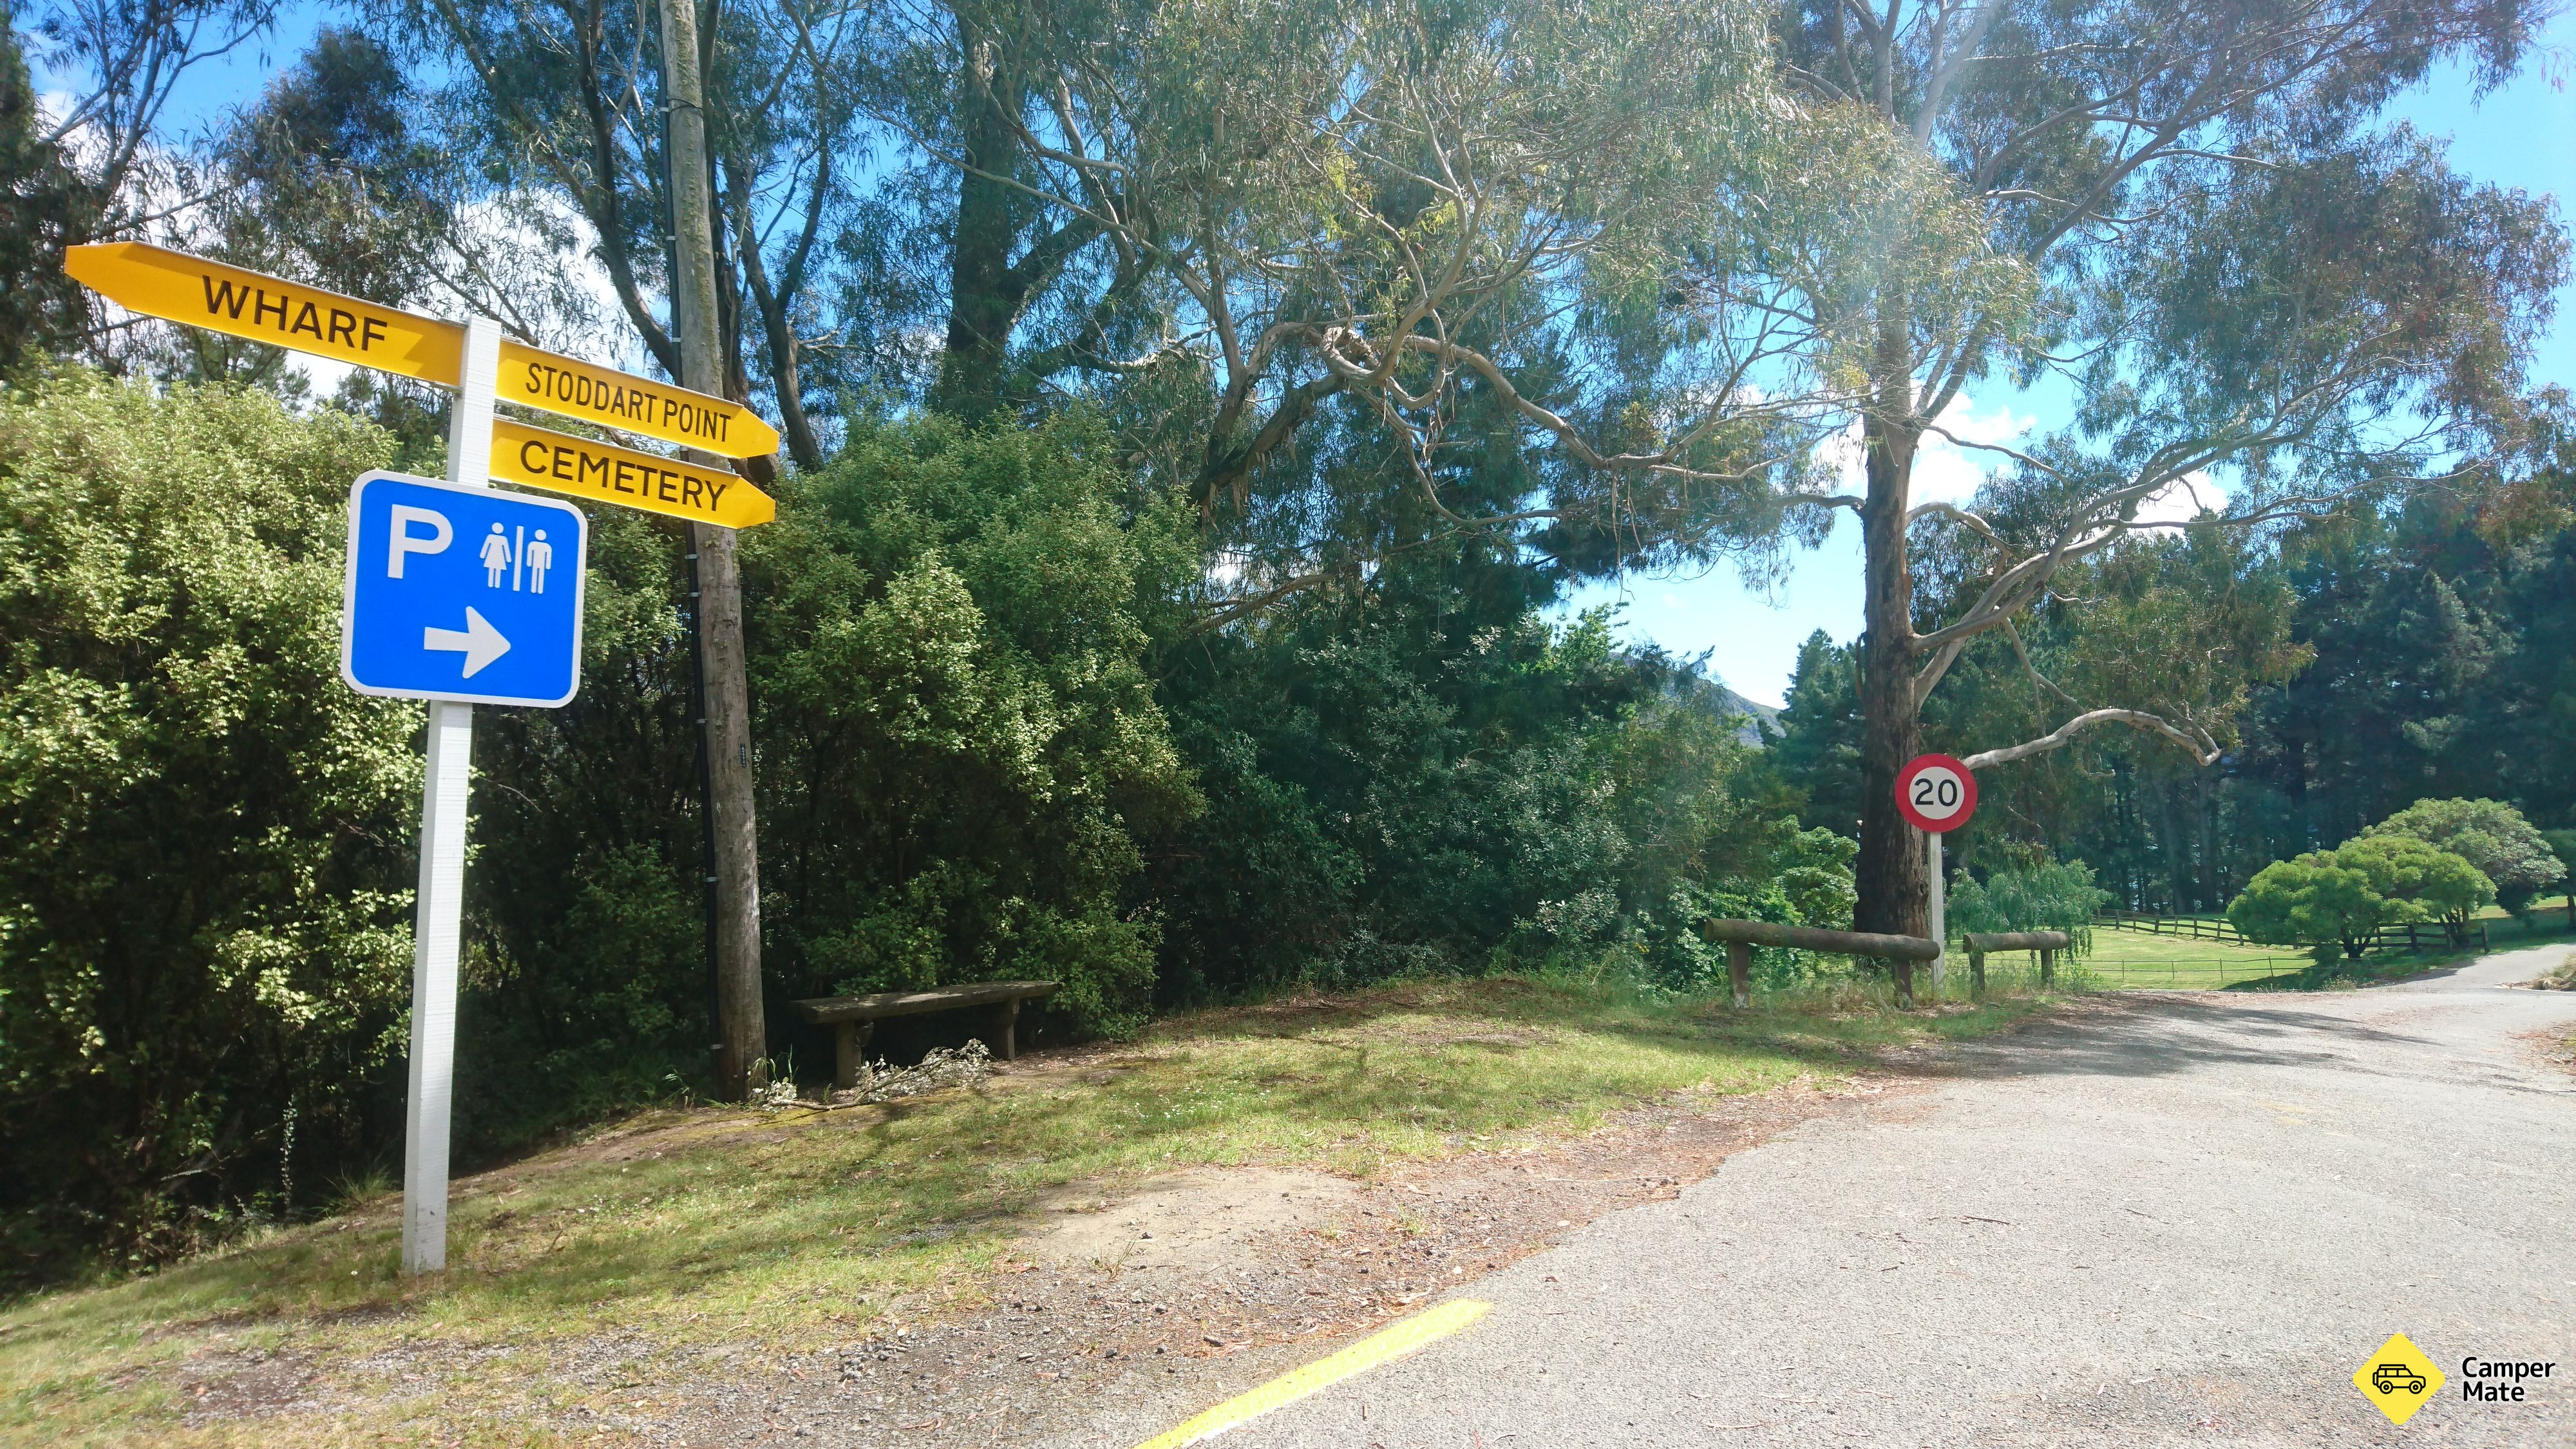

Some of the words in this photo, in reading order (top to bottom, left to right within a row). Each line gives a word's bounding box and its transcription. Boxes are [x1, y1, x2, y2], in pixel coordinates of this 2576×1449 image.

[202, 274, 388, 351] WHARF
[525, 362, 658, 423] STODDART
[663, 399, 732, 442] POINT
[520, 440, 726, 511] CEMETERY
[388, 504, 453, 579] P
[1915, 778, 1958, 807] 20
